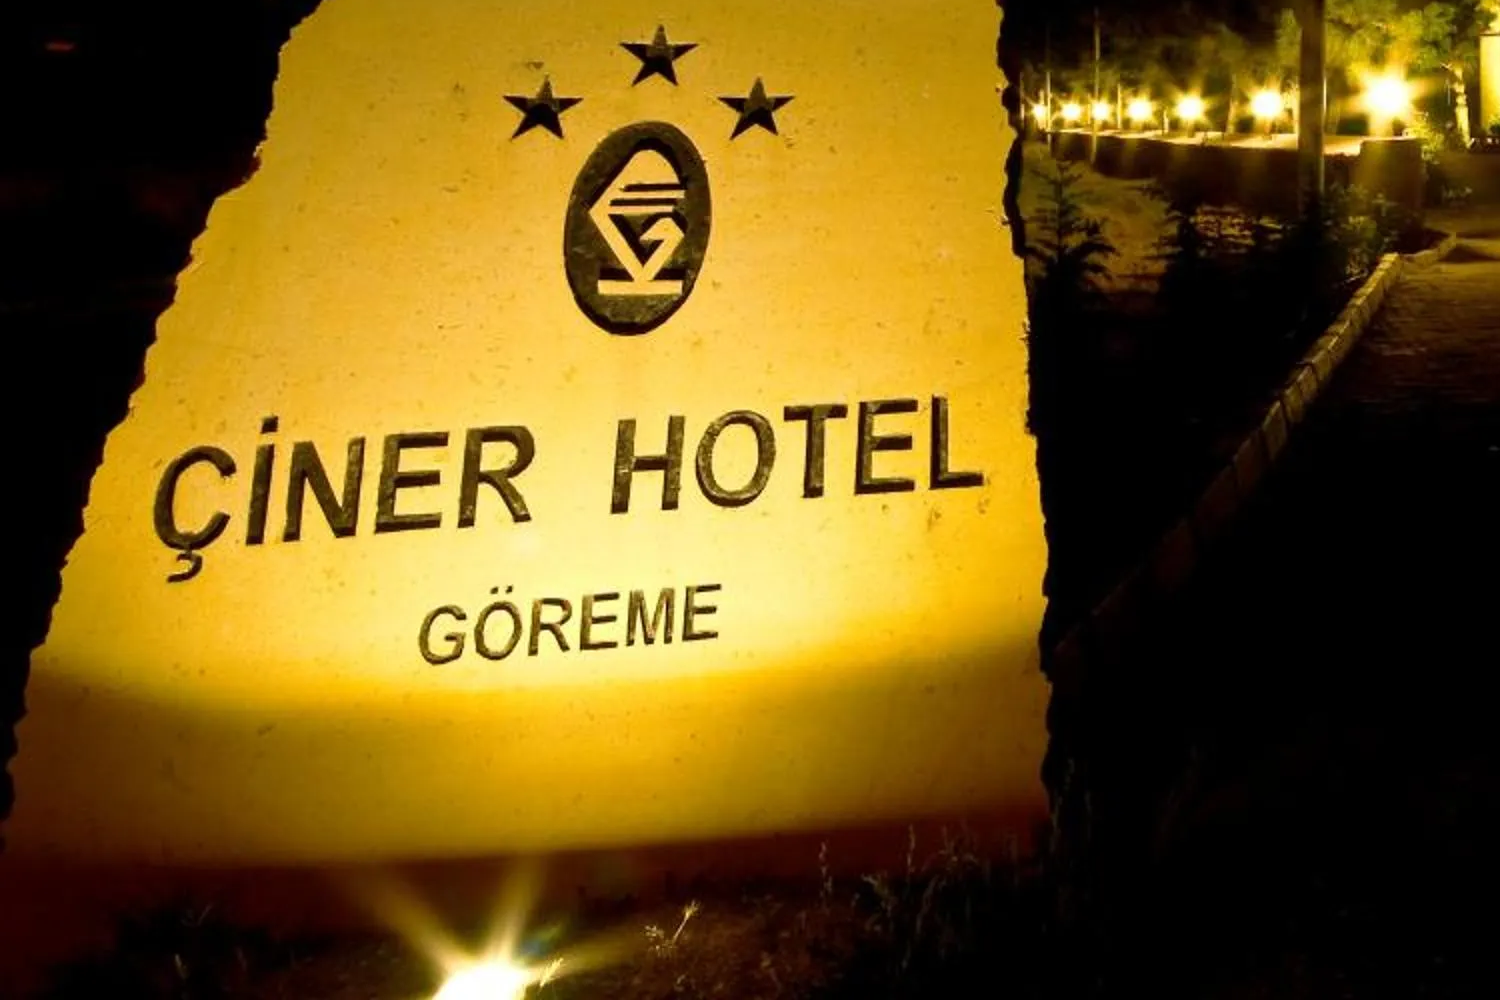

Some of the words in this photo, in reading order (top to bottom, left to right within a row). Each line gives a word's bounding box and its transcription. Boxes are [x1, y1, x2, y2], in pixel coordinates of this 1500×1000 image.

[152, 414, 536, 584] ÇİNER
[610, 394, 986, 516] HOTEL
[418, 583, 723, 666] GÖREME
